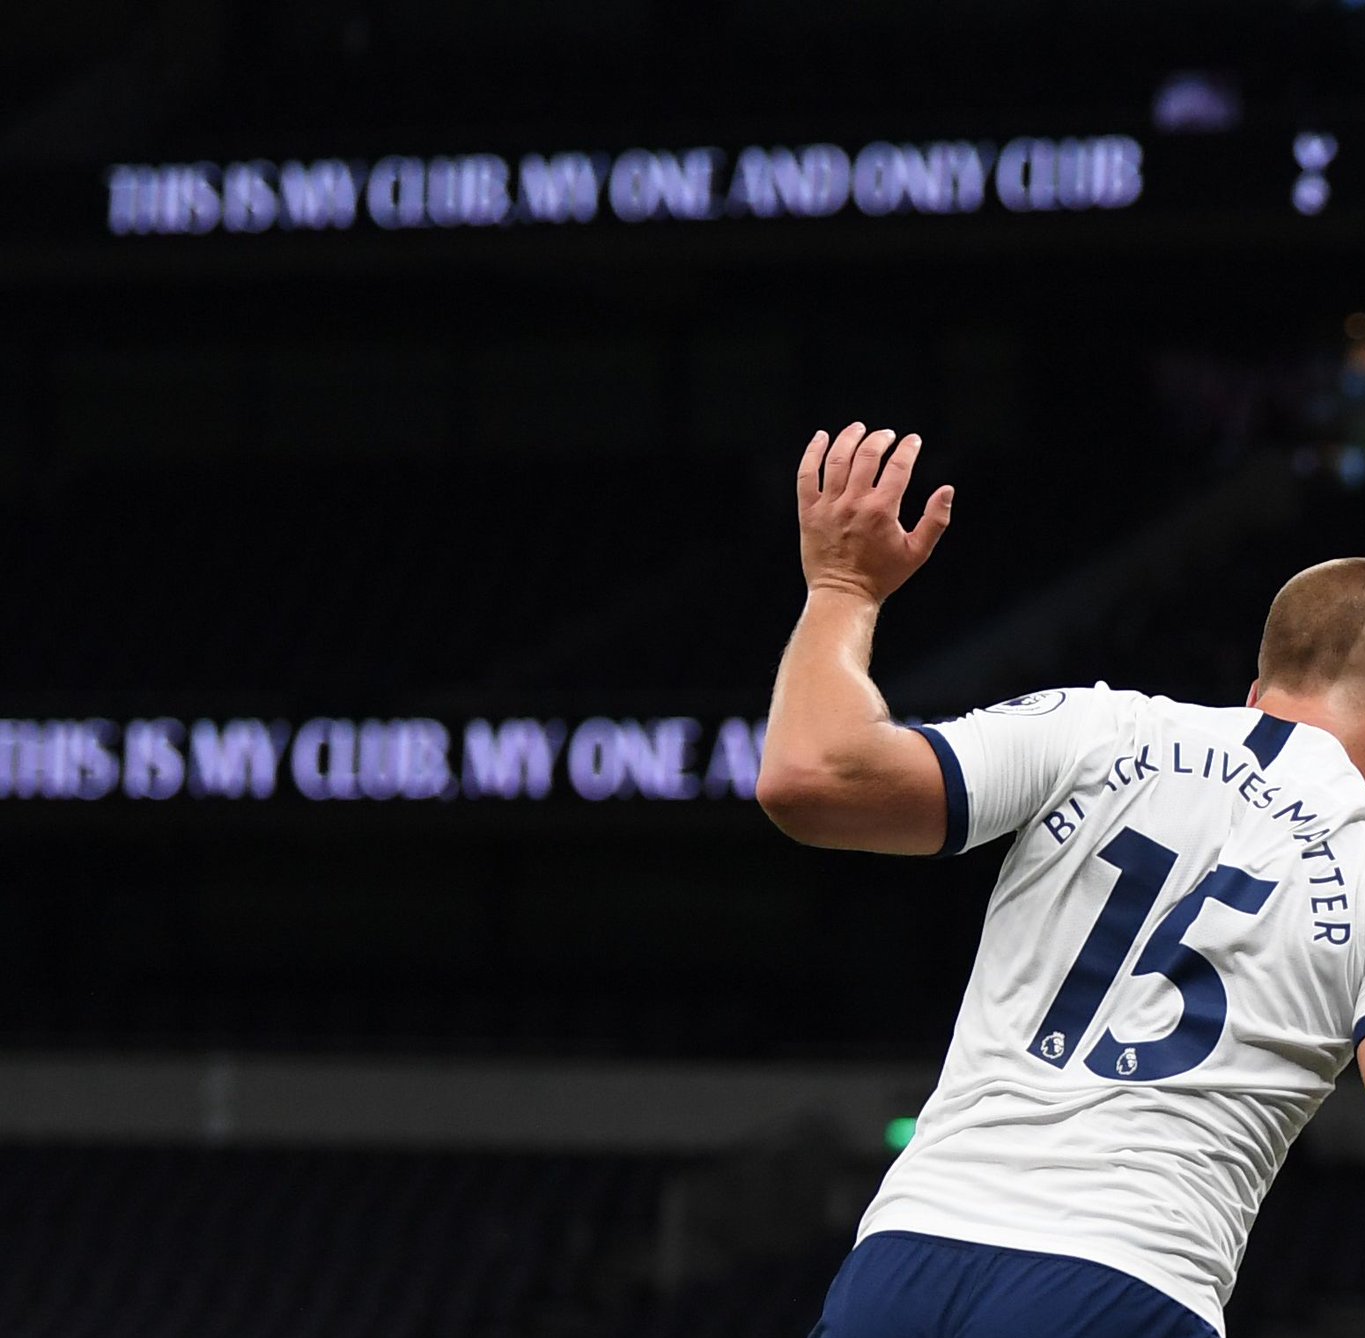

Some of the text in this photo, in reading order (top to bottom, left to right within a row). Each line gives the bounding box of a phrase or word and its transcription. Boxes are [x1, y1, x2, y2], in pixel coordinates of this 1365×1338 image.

[108, 160, 221, 235] THIS
[222, 159, 276, 233] IS
[278, 157, 366, 230] MY
[519, 150, 608, 224] MY
[609, 147, 726, 222] ONE
[727, 143, 850, 217] AND
[853, 140, 995, 216] ONLY
[996, 134, 1142, 212] CLUB
[122, 717, 186, 800] IS
[188, 717, 291, 799] MY
[462, 716, 567, 800] MY
[568, 716, 702, 800] ONE
[1174, 742, 1281, 809] LIVES
[1272, 800, 1351, 945] MATTER
[1026, 826, 1278, 1083] 15
